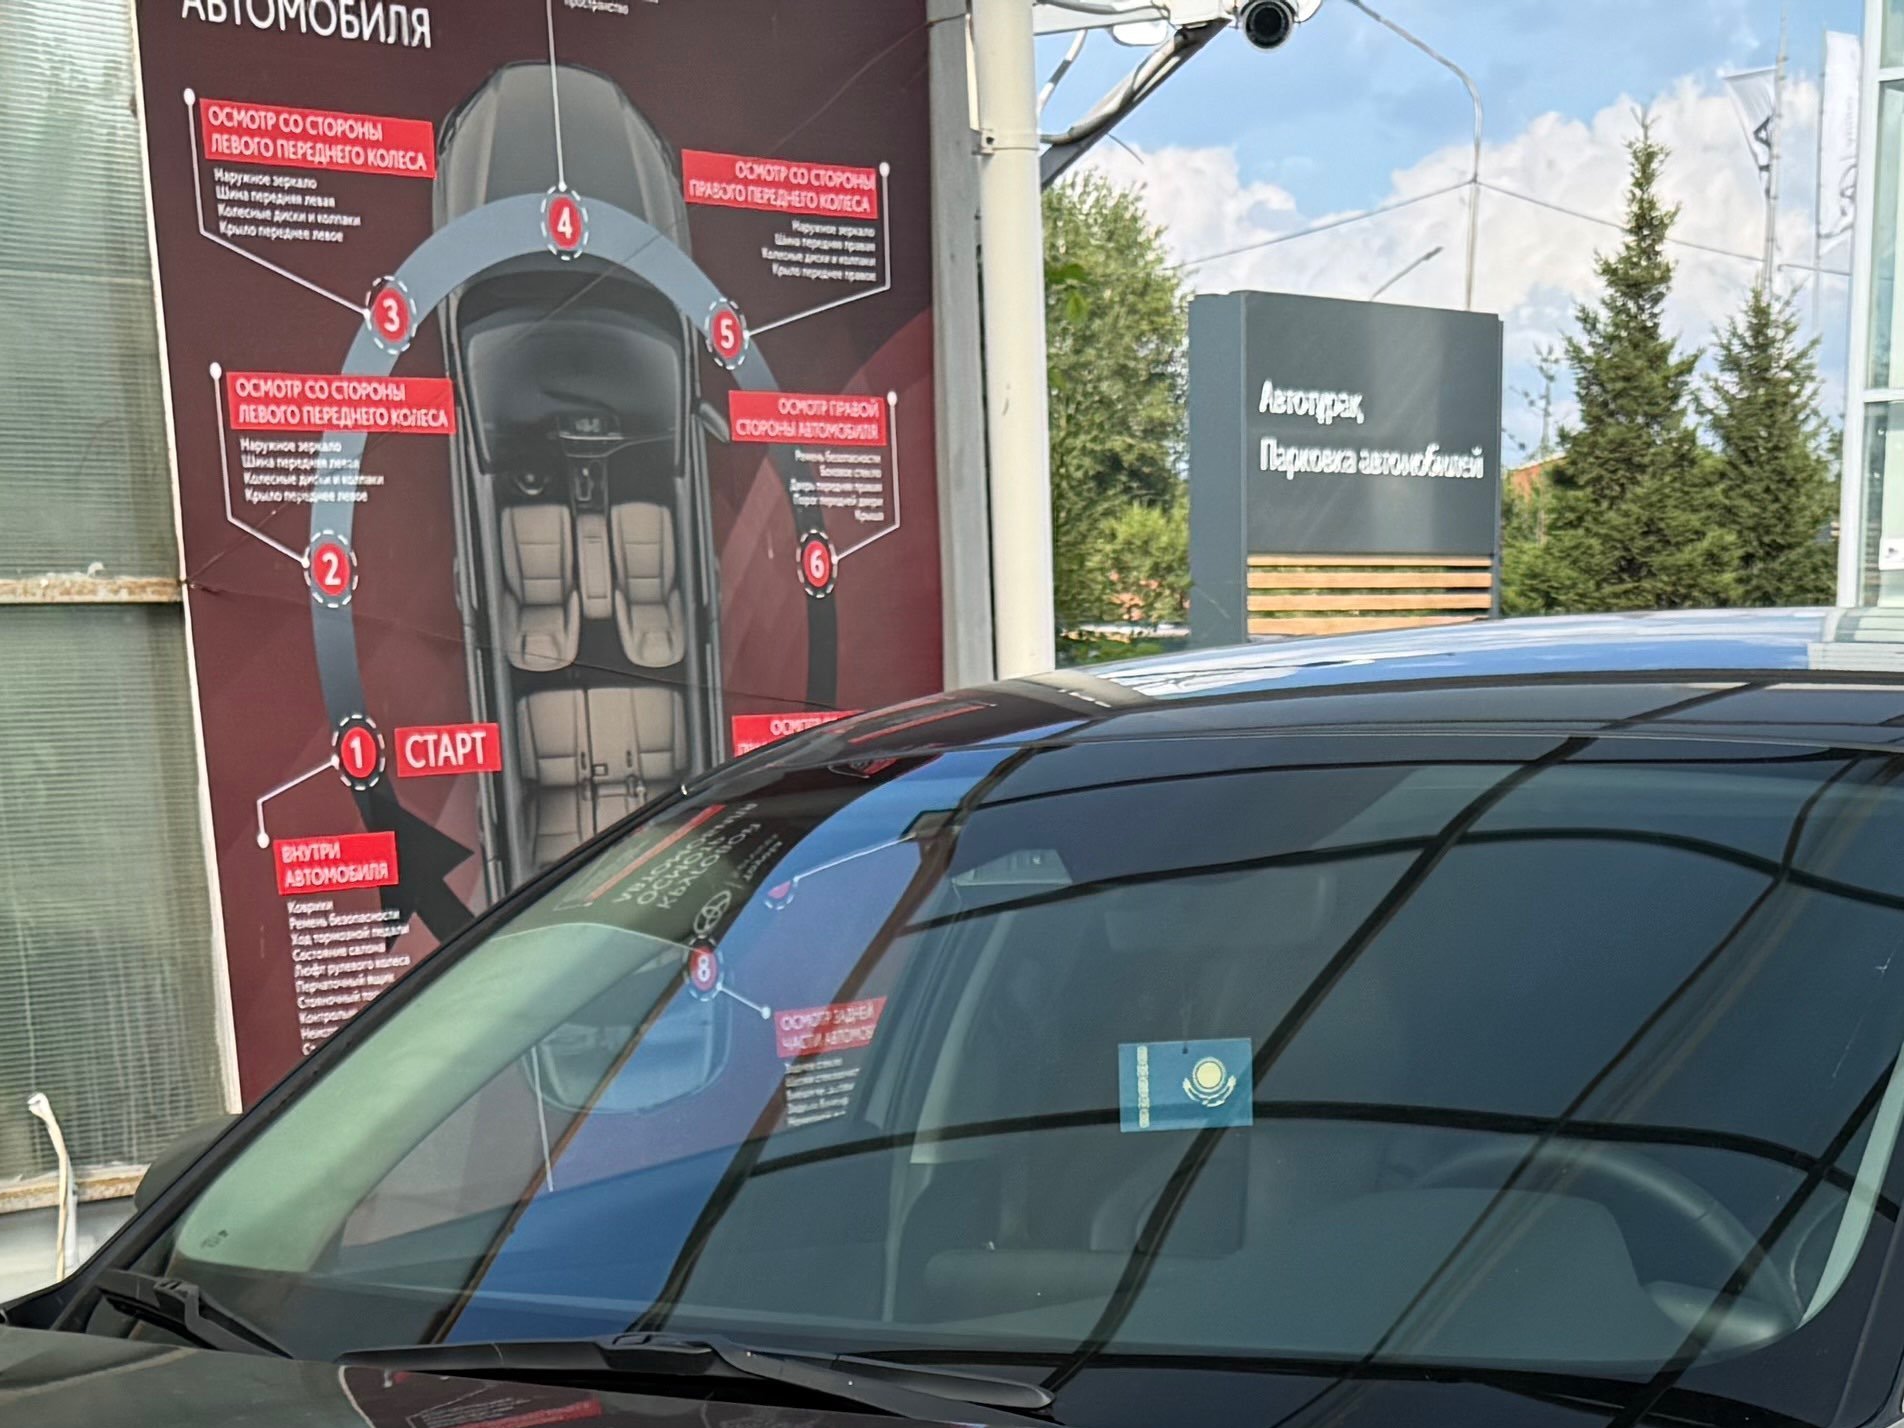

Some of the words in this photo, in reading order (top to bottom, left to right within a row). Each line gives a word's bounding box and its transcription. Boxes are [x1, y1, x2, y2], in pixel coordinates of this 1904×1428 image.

[182, 0, 431, 48] АВТОМОБИЛЯ
[208, 106, 275, 131] ОСМОТР
[279, 114, 303, 133] СО
[306, 116, 382, 141] СТОРОНЫ
[212, 134, 272, 157] ЛЕВОГО
[276, 139, 364, 167] ПЕРЕДНЕГО
[368, 149, 427, 171] КОЛЕСА
[736, 161, 787, 182] ОСМОТР
[789, 168, 808, 184] СО
[811, 169, 876, 190] СТОРОНЫ
[690, 179, 745, 202] ПРАВОГО
[748, 186, 818, 208] ПЕРЕДНЕГО
[820, 194, 870, 213] КОЛЕСА
[557, 207, 572, 239] 4
[383, 298, 399, 332] 3
[720, 319, 735, 349] 5
[236, 379, 302, 397] ОСМОТР
[305, 381, 328, 398] СО
[332, 382, 405, 401] СТОРОНЫ
[239, 406, 299, 424] ЛЕВОГО
[303, 407, 388, 427] ПЕРЕДНЕГО
[391, 410, 448, 427] КОЛЕСА
[778, 398, 827, 415] ОСМОТР
[829, 399, 878, 418] ПРАВОЙ
[736, 419, 795, 437] СТОРОНЫ
[1261, 437, 1357, 480] Парковка
[1359, 443, 1484, 478] автомобилей
[322, 552, 341, 585] 2
[811, 550, 825, 579] 6
[350, 736, 363, 769] 1
[405, 731, 486, 768] СТАРТ
[281, 842, 340, 863] ВНУТРИ
[285, 863, 388, 887] АВТОМОБИЛЯ
[698, 957, 710, 981] 8
